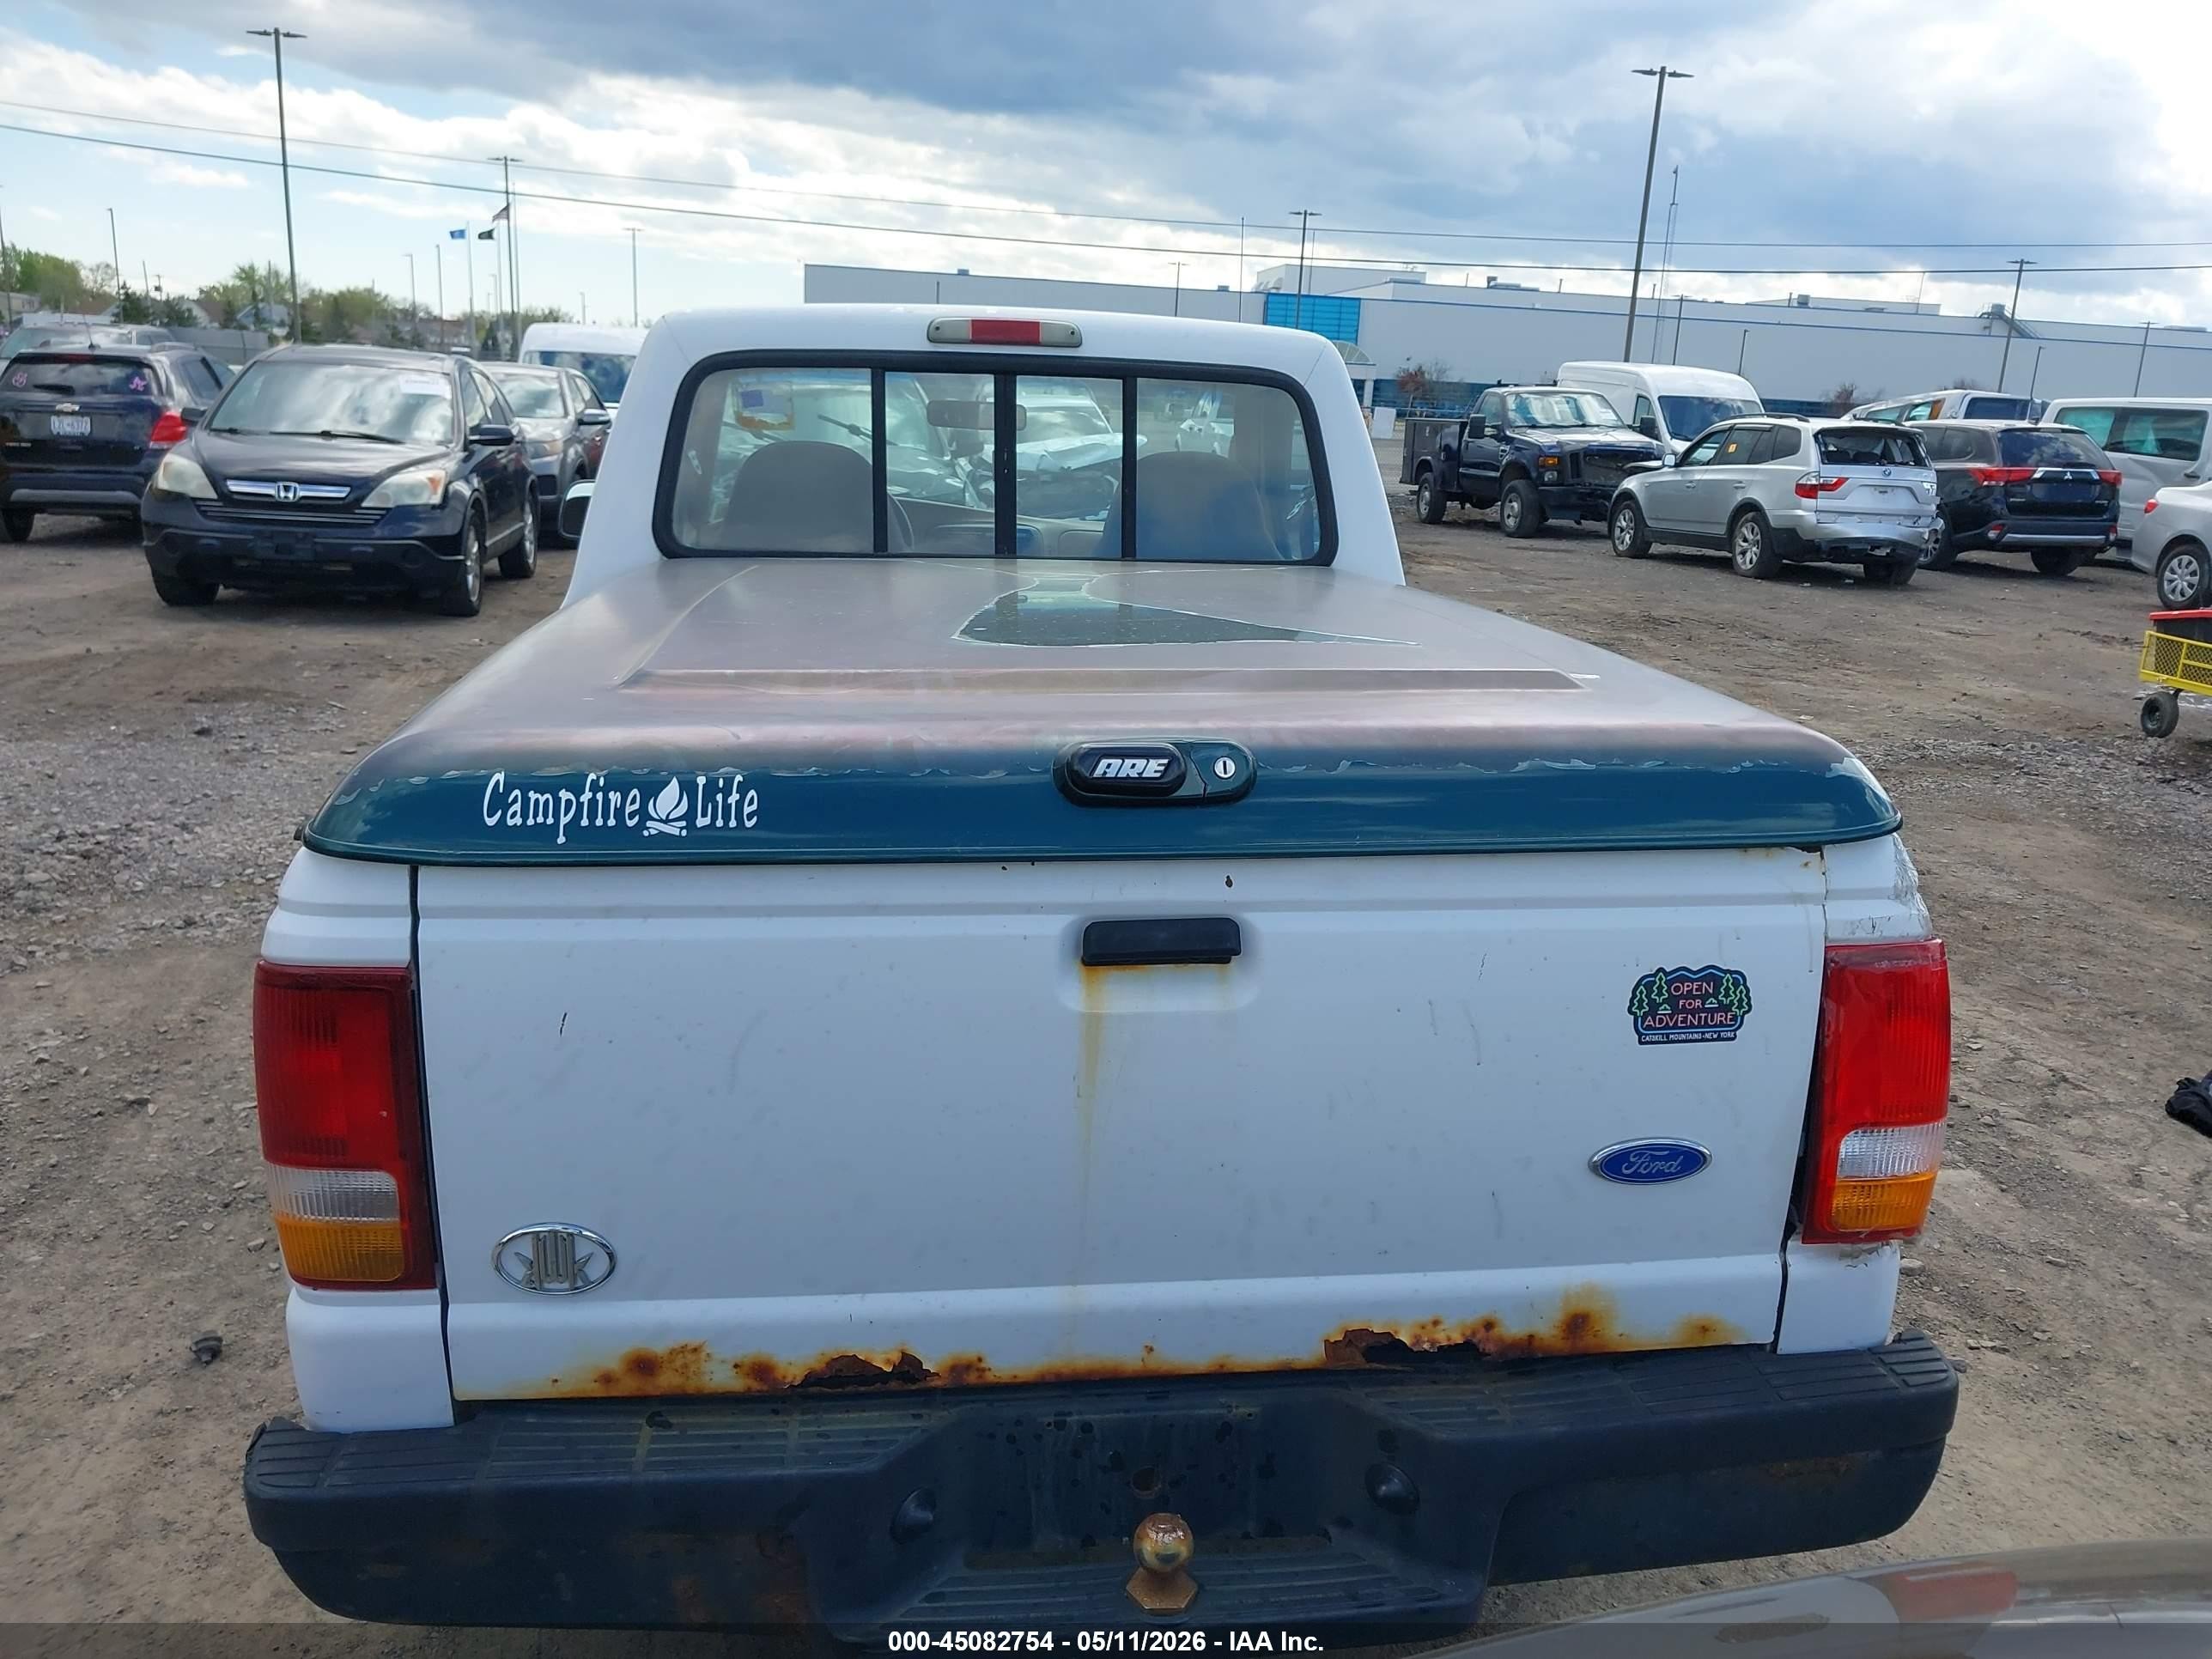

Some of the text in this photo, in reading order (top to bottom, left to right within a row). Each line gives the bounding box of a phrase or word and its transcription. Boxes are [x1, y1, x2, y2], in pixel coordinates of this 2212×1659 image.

[1092, 758, 1170, 778] ARE
[483, 771, 758, 844] Campfire Life
[1670, 981, 1714, 995] OPEN
[1679, 1000, 1703, 1009] FOR
[1643, 1012, 1735, 1028] ADVENTURE
[1622, 1151, 1684, 1175] Ford
